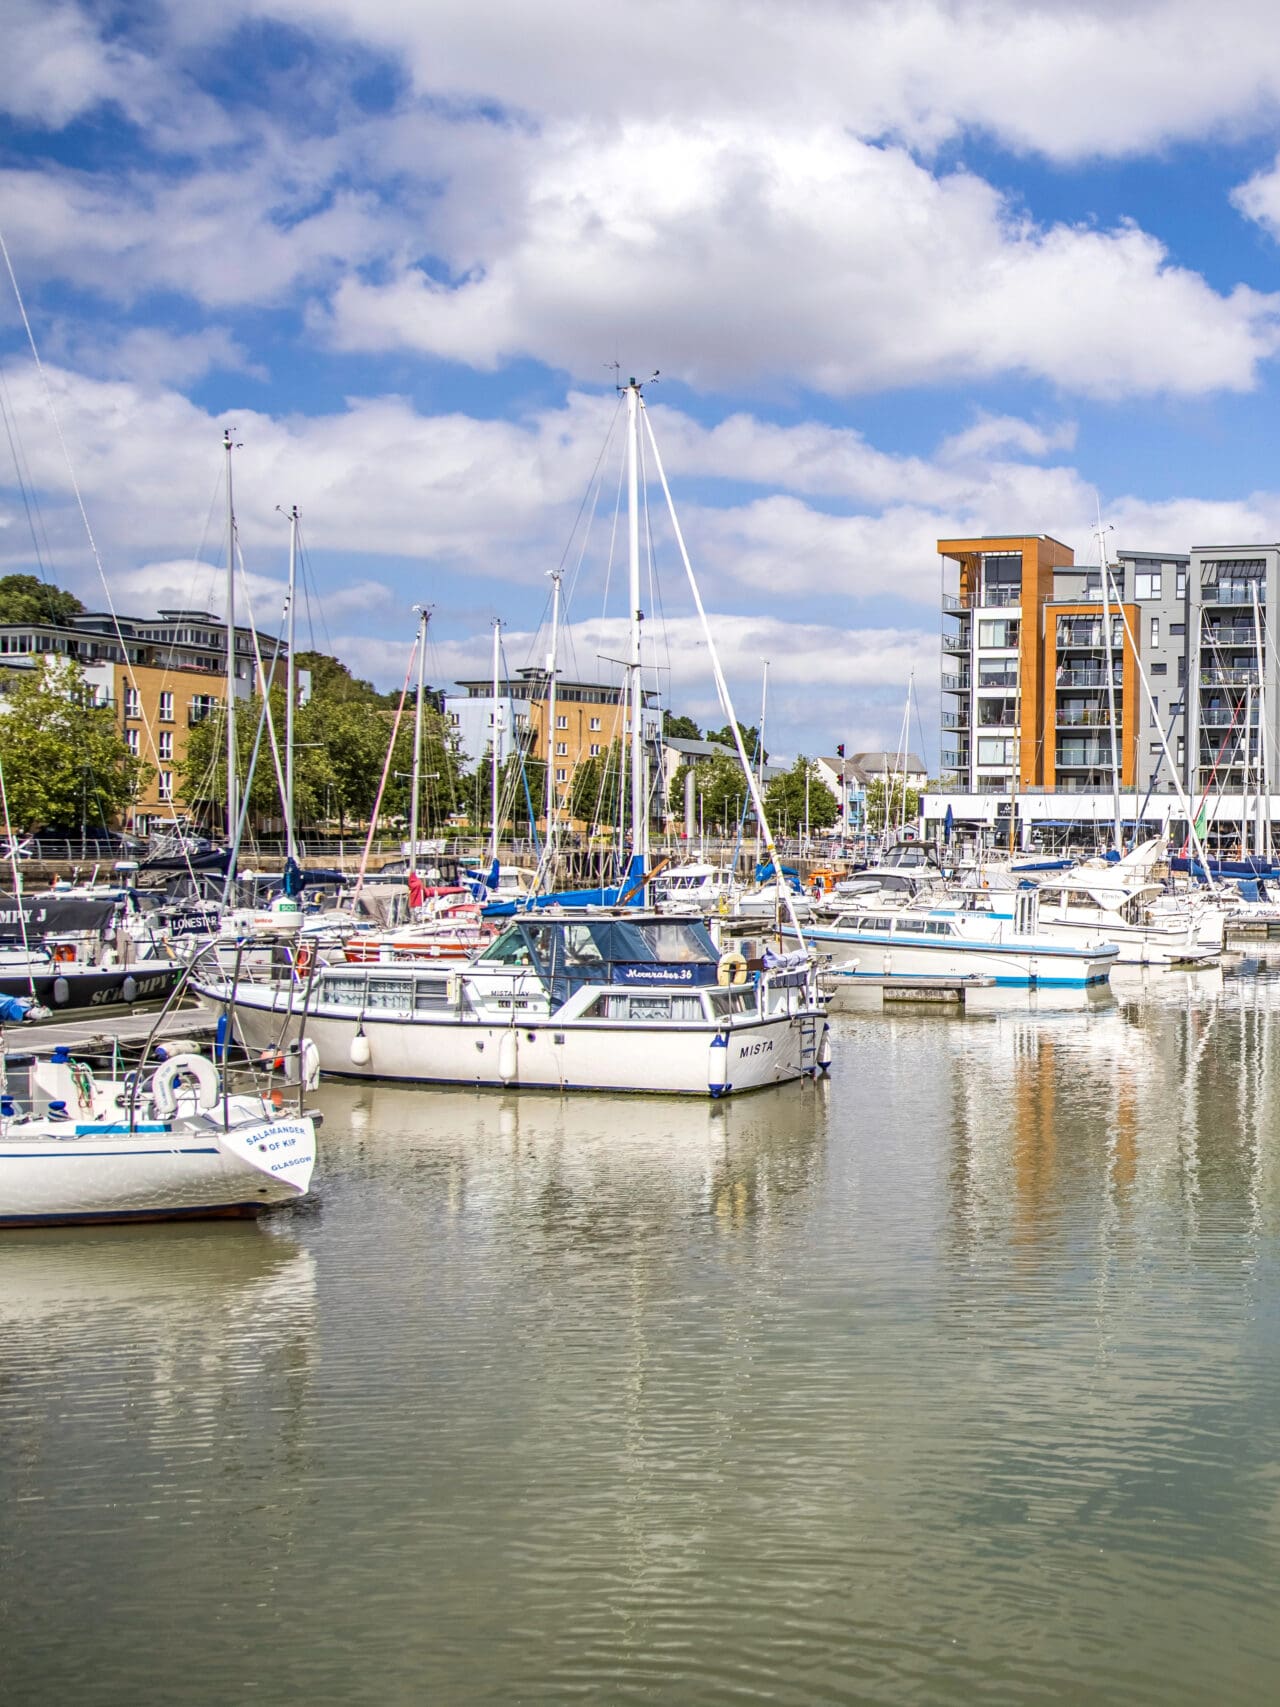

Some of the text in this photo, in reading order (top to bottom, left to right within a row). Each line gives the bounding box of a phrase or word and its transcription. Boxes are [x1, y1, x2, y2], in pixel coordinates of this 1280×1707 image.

[36, 908, 47, 922] J
[172, 916, 218, 931] LONESTAR
[740, 1040, 773, 1058] MISTA
[246, 1126, 305, 1145] SALAMANDER
[269, 1142, 280, 1151] OF
[271, 1156, 312, 1171] GLASGOW
